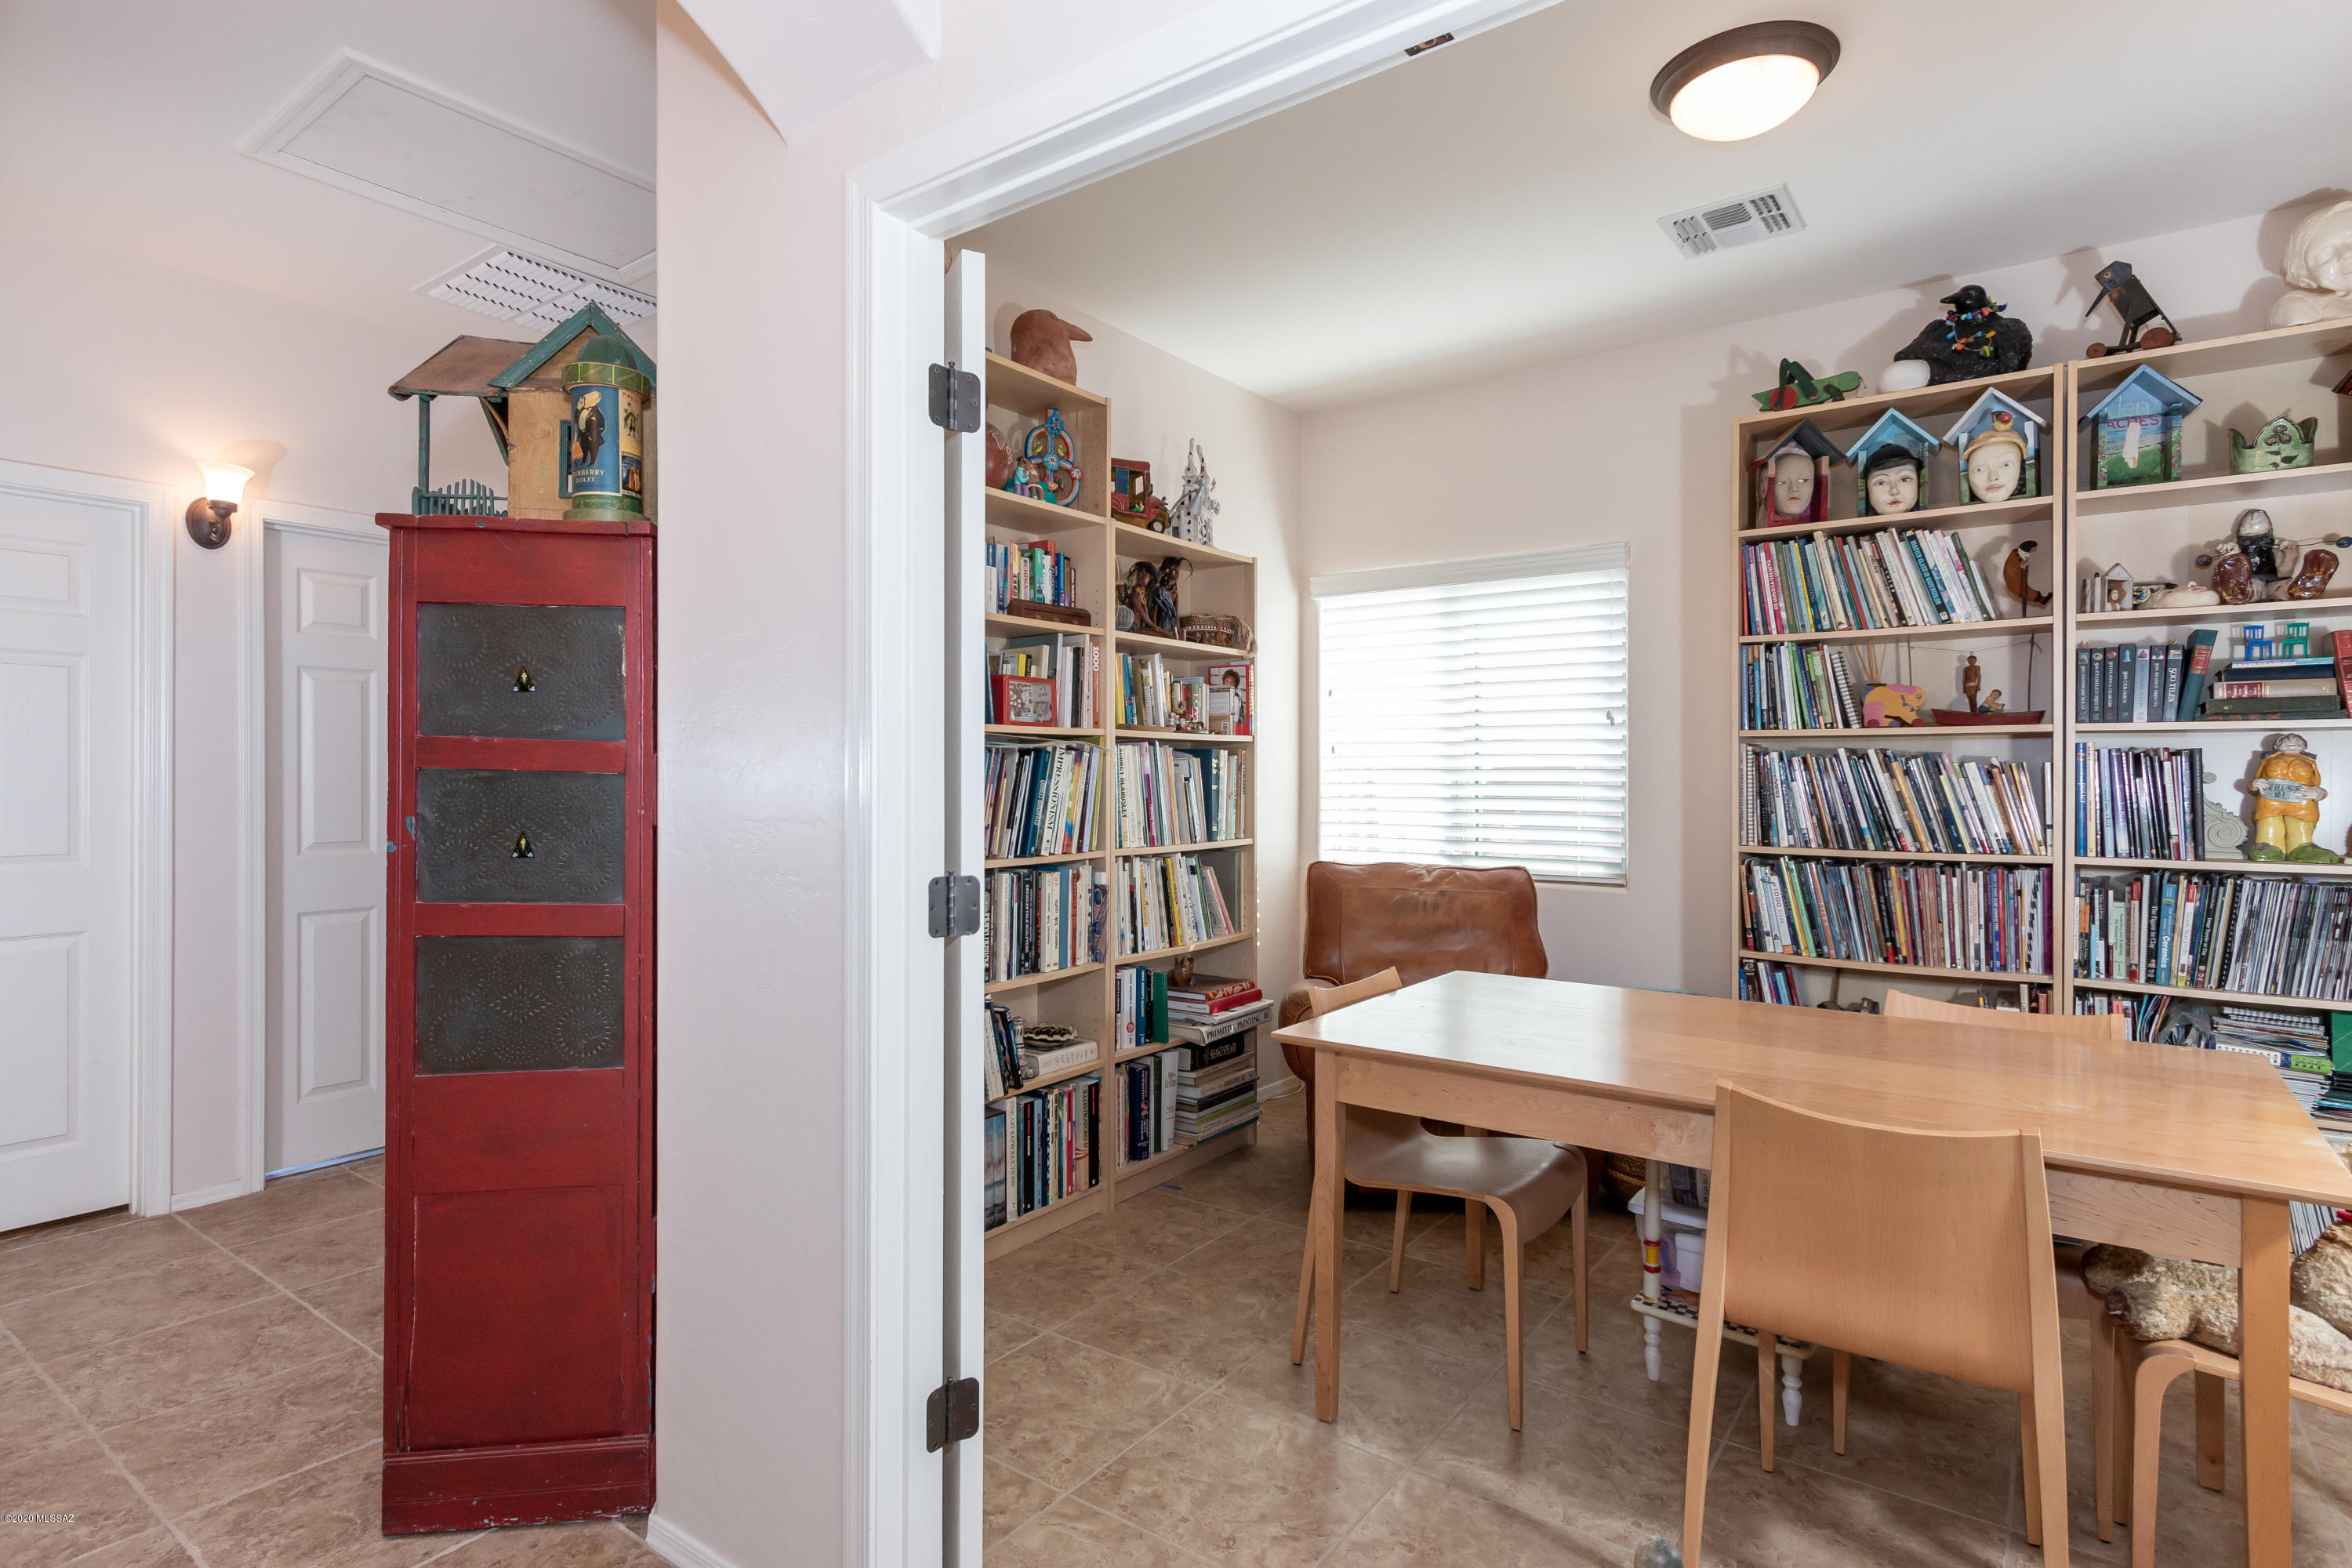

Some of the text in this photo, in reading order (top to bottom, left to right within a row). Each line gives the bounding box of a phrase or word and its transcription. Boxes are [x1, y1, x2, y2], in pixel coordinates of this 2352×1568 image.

[1909, 539, 1922, 559] MASTER
[1917, 557, 1929, 572] CLASS
[1925, 575, 1942, 605] WATERCOLOR
[2168, 667, 2176, 681] 500
[1047, 746, 1065, 829] IMPRESSIONISM
[2160, 935, 2170, 968] Ceramics
[1207, 1022, 1236, 1040] PRIMITIVE
[1237, 1014, 1261, 1029] PAINTING
[1210, 1043, 1237, 1059] SHAKESPEARE
